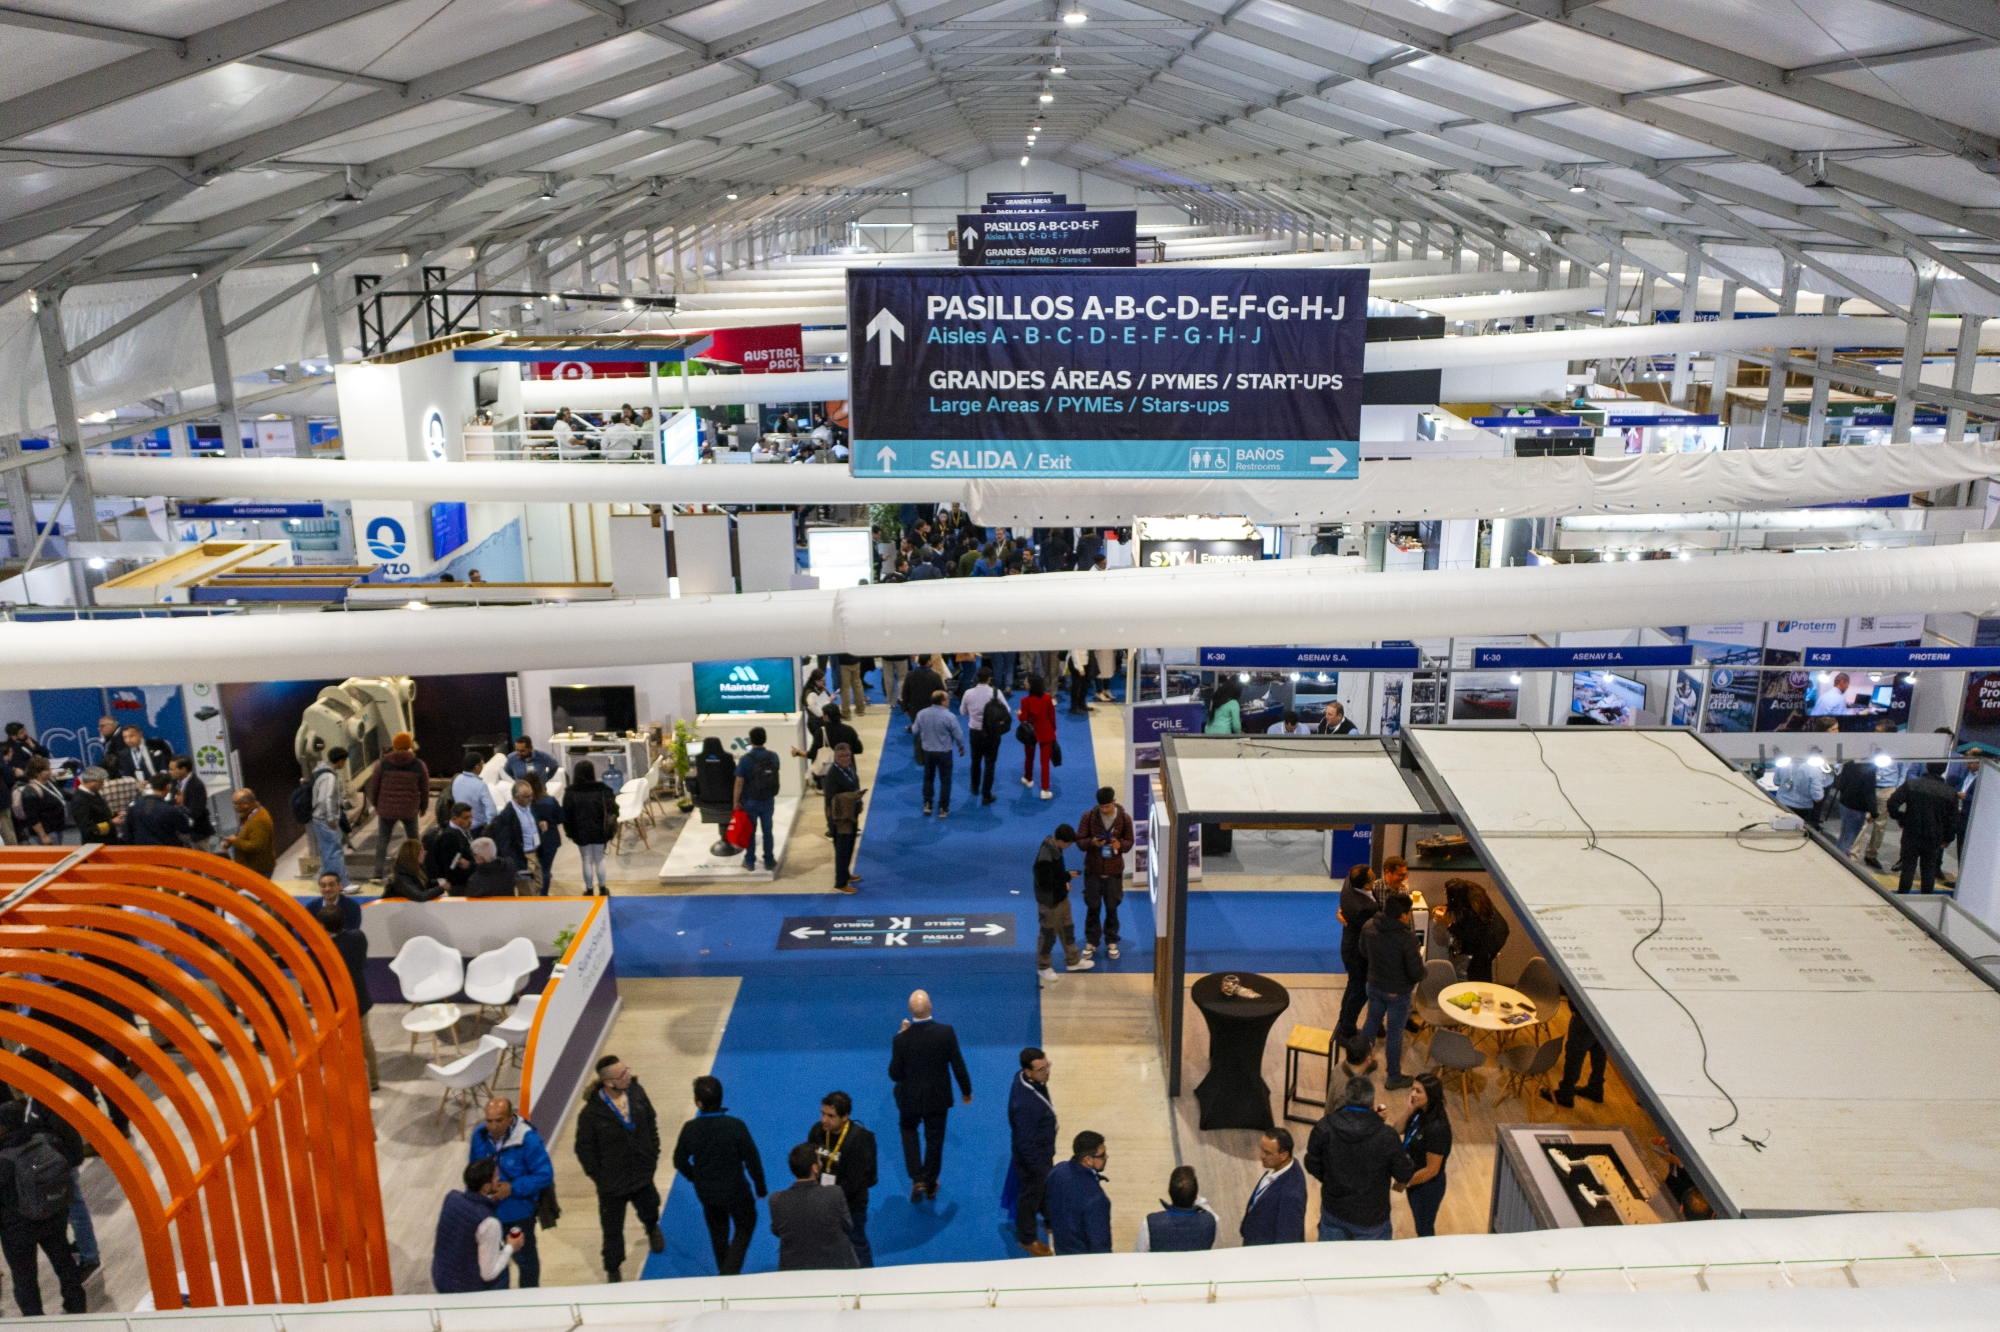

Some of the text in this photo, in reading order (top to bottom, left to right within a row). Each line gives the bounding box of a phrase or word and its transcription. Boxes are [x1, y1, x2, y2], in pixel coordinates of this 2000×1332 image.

[984, 220, 1099, 232] PASILLOS A-B-C-D-E-F
[985, 248, 1027, 257] GRANDES
[1028, 247, 1057, 256] ÁREAS
[985, 257, 1005, 266] Large
[927, 294, 1346, 320] PASILLOS A-B-C-D-E-F-G-H-J
[926, 326, 987, 344] Aisles
[744, 347, 800, 362] AUSTRAL
[769, 358, 800, 370] PACK
[929, 370, 1046, 389] GRANDES
[1051, 367, 1132, 390] ÁREAS
[1151, 373, 1218, 390] PYMES
[1236, 373, 1343, 390] START-UPS
[929, 396, 982, 416] Large
[986, 396, 1040, 413] Areas
[1058, 396, 1124, 413] PYMEs
[1142, 396, 1230, 415] Stars-ups
[930, 450, 1018, 469] SALIDA
[1038, 453, 1072, 469] Exit
[1236, 447, 1285, 461] BAÑOS
[1235, 462, 1281, 471] Restrooms
[372, 563, 411, 575] XZO
[1790, 620, 1837, 633] Proterm
[1297, 653, 1331, 662] ASENAV
[1332, 653, 1349, 662] S.A.
[1482, 652, 1623, 662] K-30 ASENAV S.A.
[1812, 653, 1951, 661] K-23 PROTERM
[719, 682, 770, 693] Mainstay
[1709, 692, 1735, 700] estión
[1151, 719, 1182, 730] CHILE
[888, 916, 912, 929] K
[885, 932, 909, 946] K
